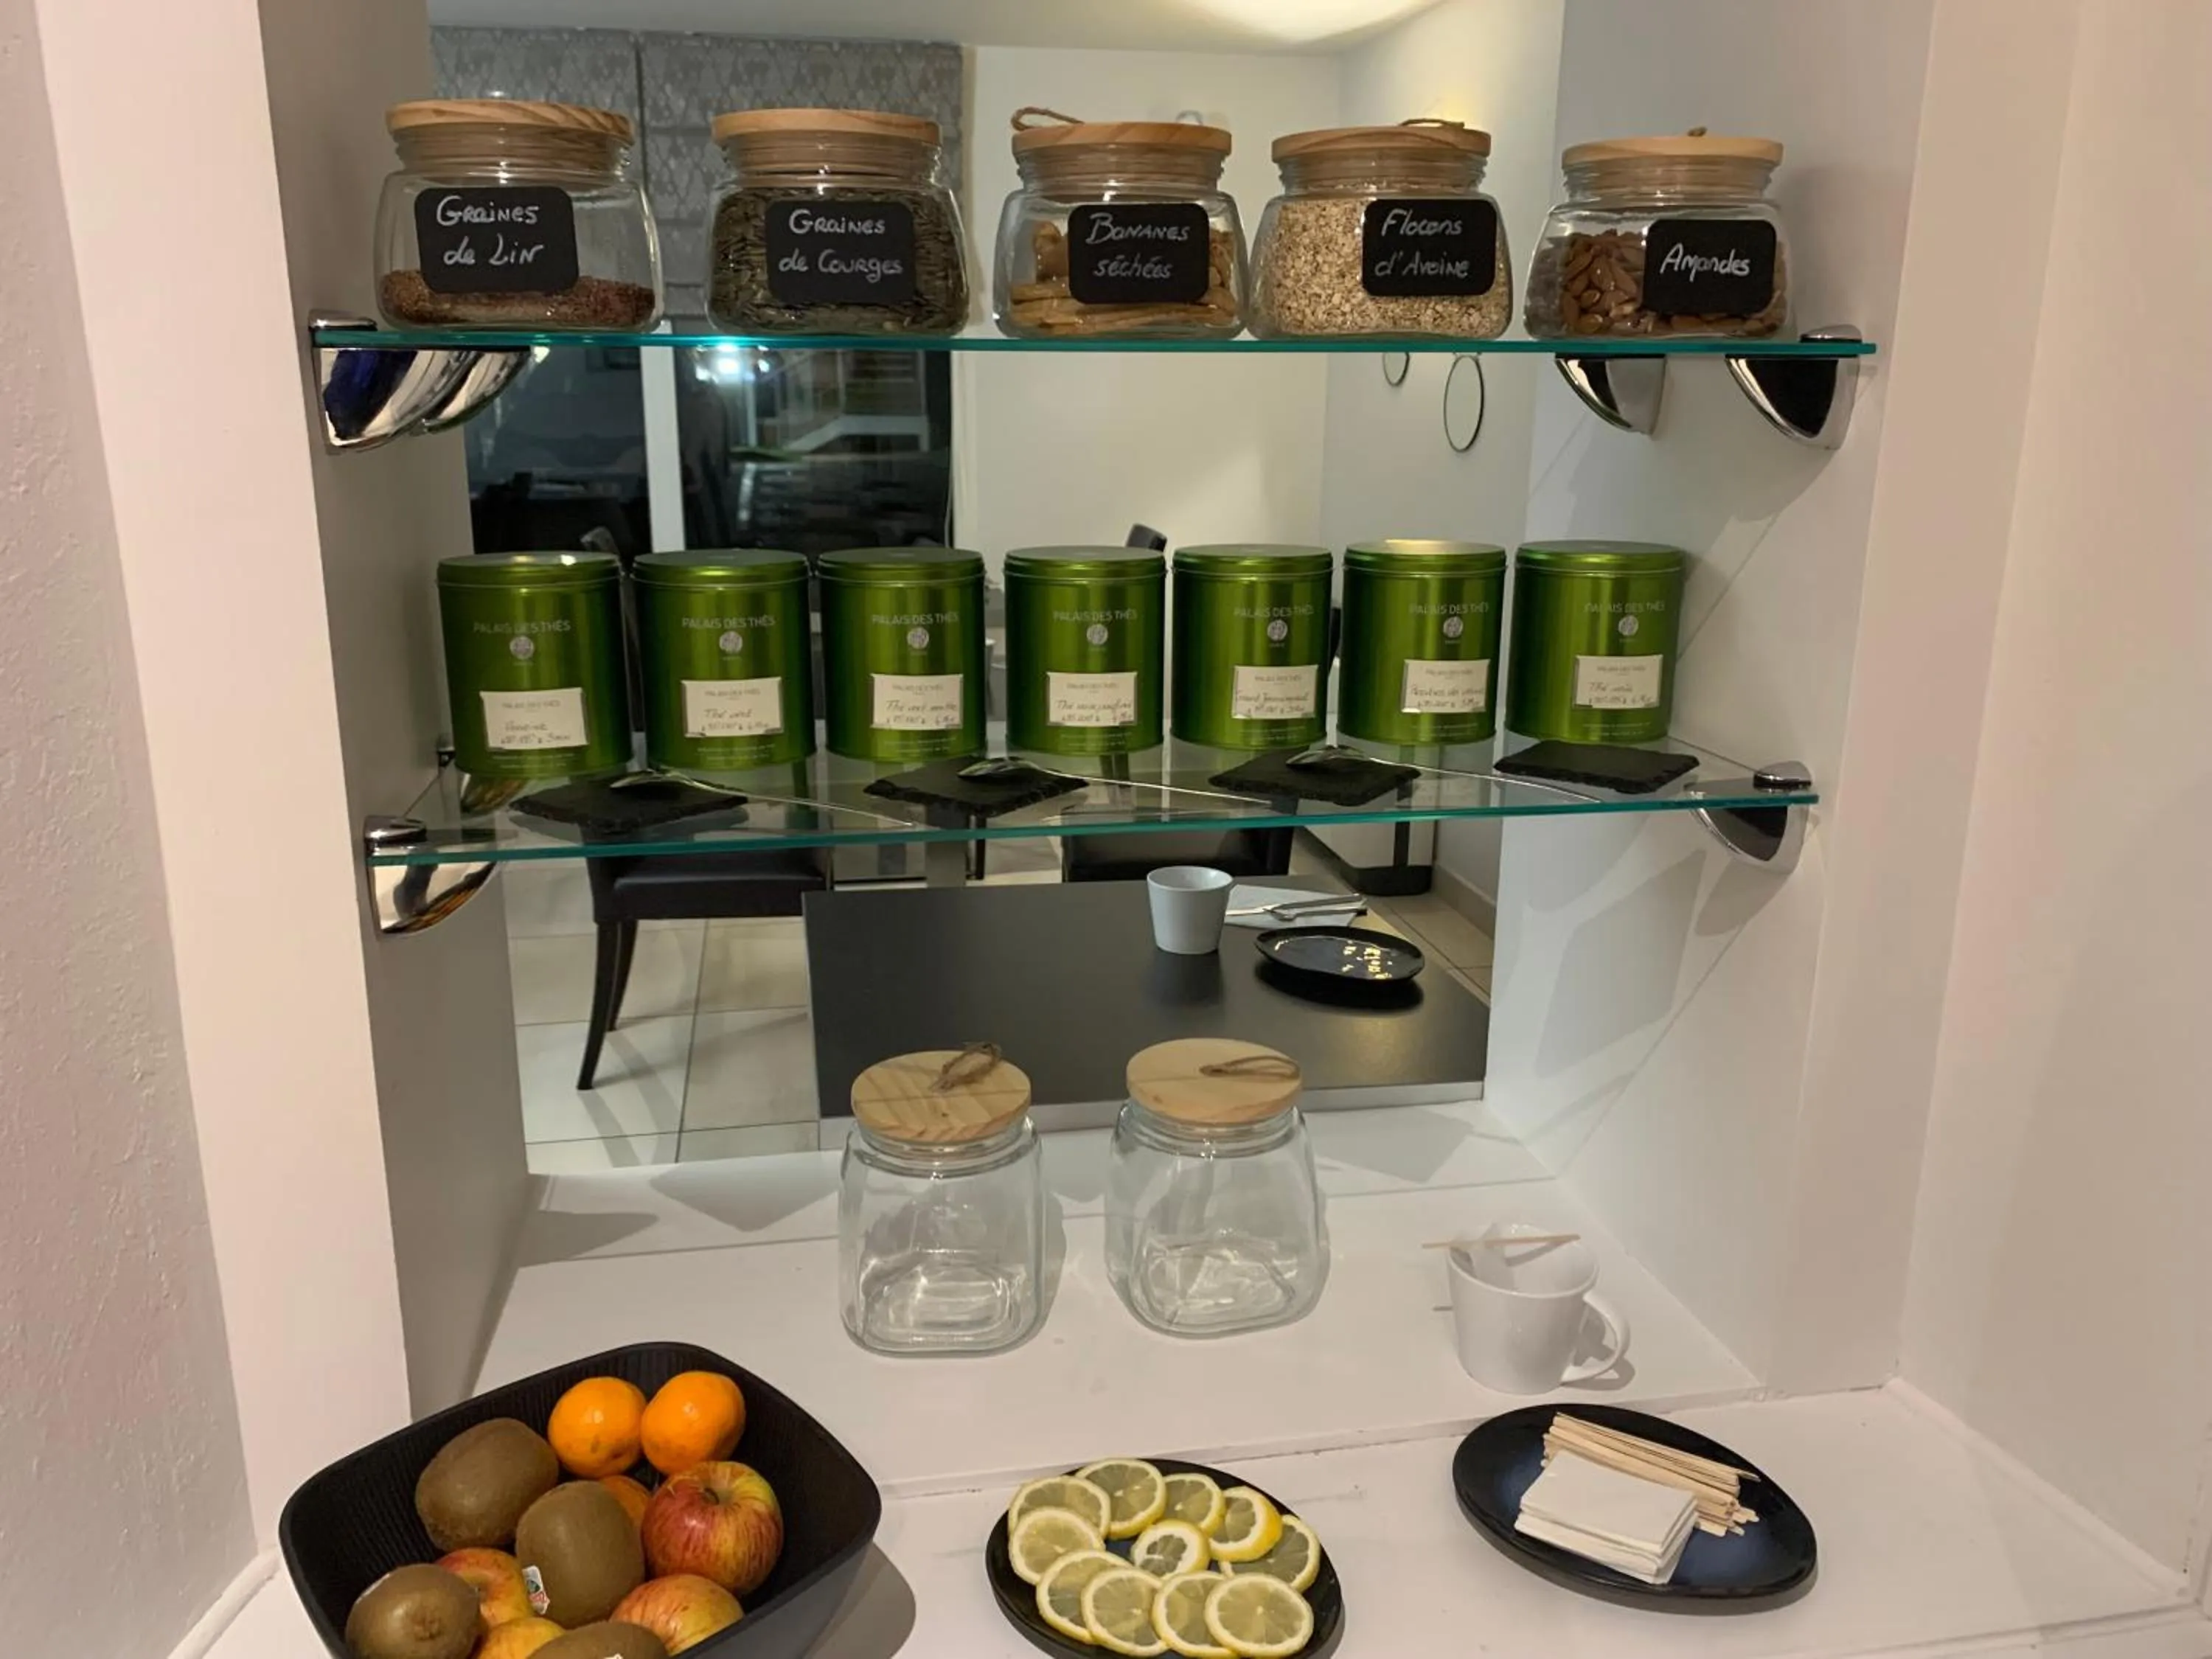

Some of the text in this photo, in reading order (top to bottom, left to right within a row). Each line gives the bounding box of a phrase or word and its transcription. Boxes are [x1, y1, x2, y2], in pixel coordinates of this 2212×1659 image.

[437, 195, 539, 226] Graines
[789, 209, 886, 234] Graines
[1381, 209, 1462, 237] Flocons
[443, 236, 476, 265] de
[1660, 243, 1750, 282] Amandes
[779, 248, 903, 283] de Courges
[1093, 253, 1172, 278] séchées
[682, 617, 722, 627] PALAIS
